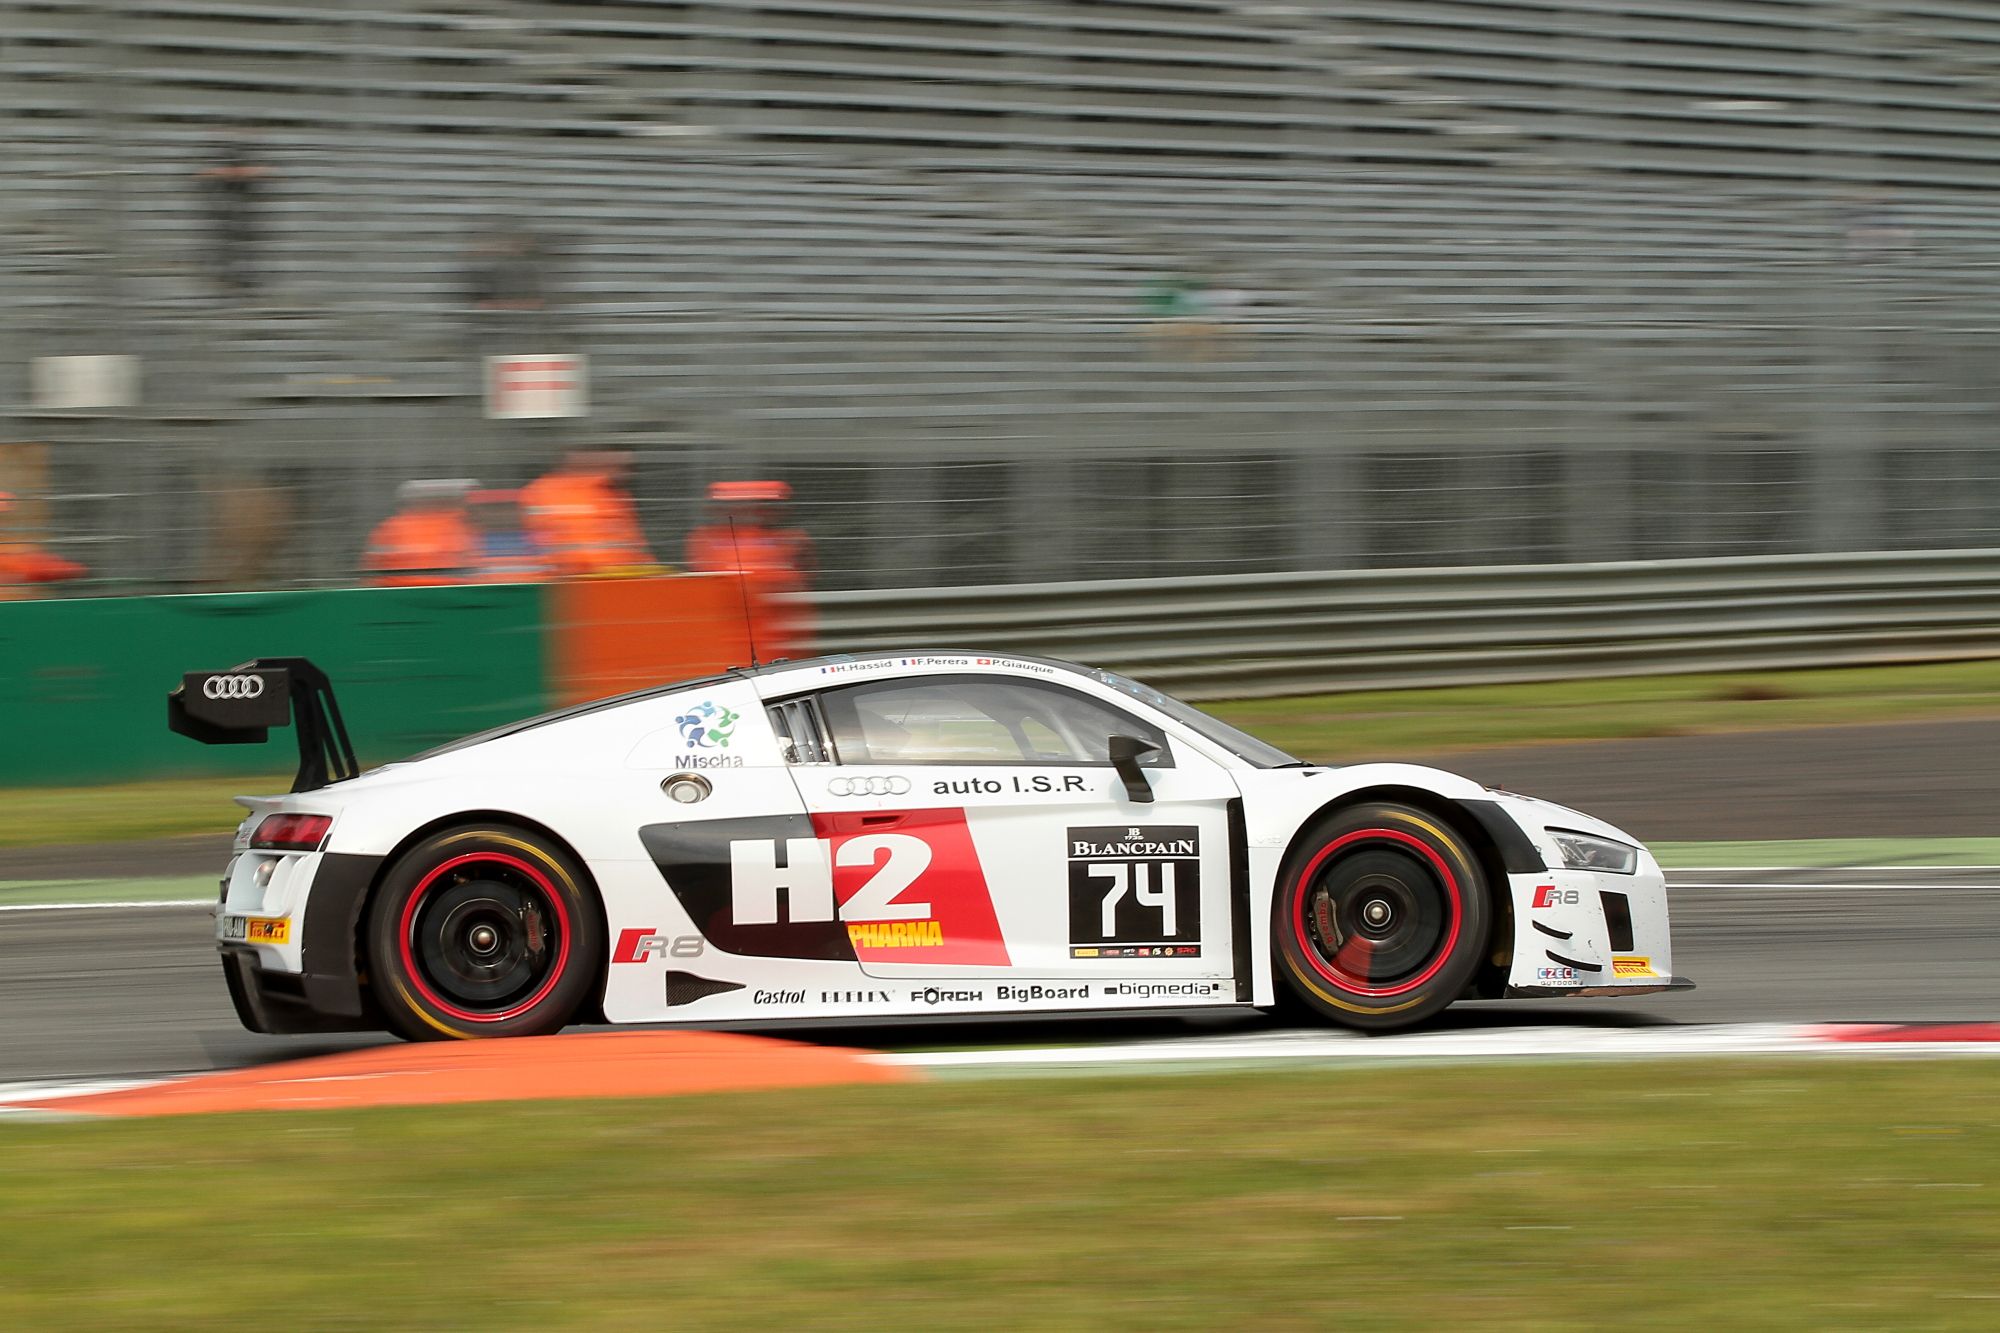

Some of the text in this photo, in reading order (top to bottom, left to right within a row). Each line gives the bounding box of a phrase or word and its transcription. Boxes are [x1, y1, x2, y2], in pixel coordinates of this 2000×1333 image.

[836, 660, 893, 673] H.Hassid
[916, 658, 968, 666] F.Perera
[992, 659, 1054, 674] P.Giauque
[675, 754, 744, 769] Mischa
[933, 775, 1095, 795] auto I.S.R.
[1072, 840, 1195, 856] BLANCPAIN
[730, 833, 932, 925] H2
[1088, 862, 1177, 938] 74
[1543, 889, 1579, 905] R8
[848, 921, 944, 949] PHARMA
[629, 933, 705, 960] R8
[1538, 968, 1580, 979] CZECH
[753, 989, 806, 1005] Castrol
[997, 985, 1090, 1003] BigBoard
[1119, 983, 1211, 999] bigmedia
